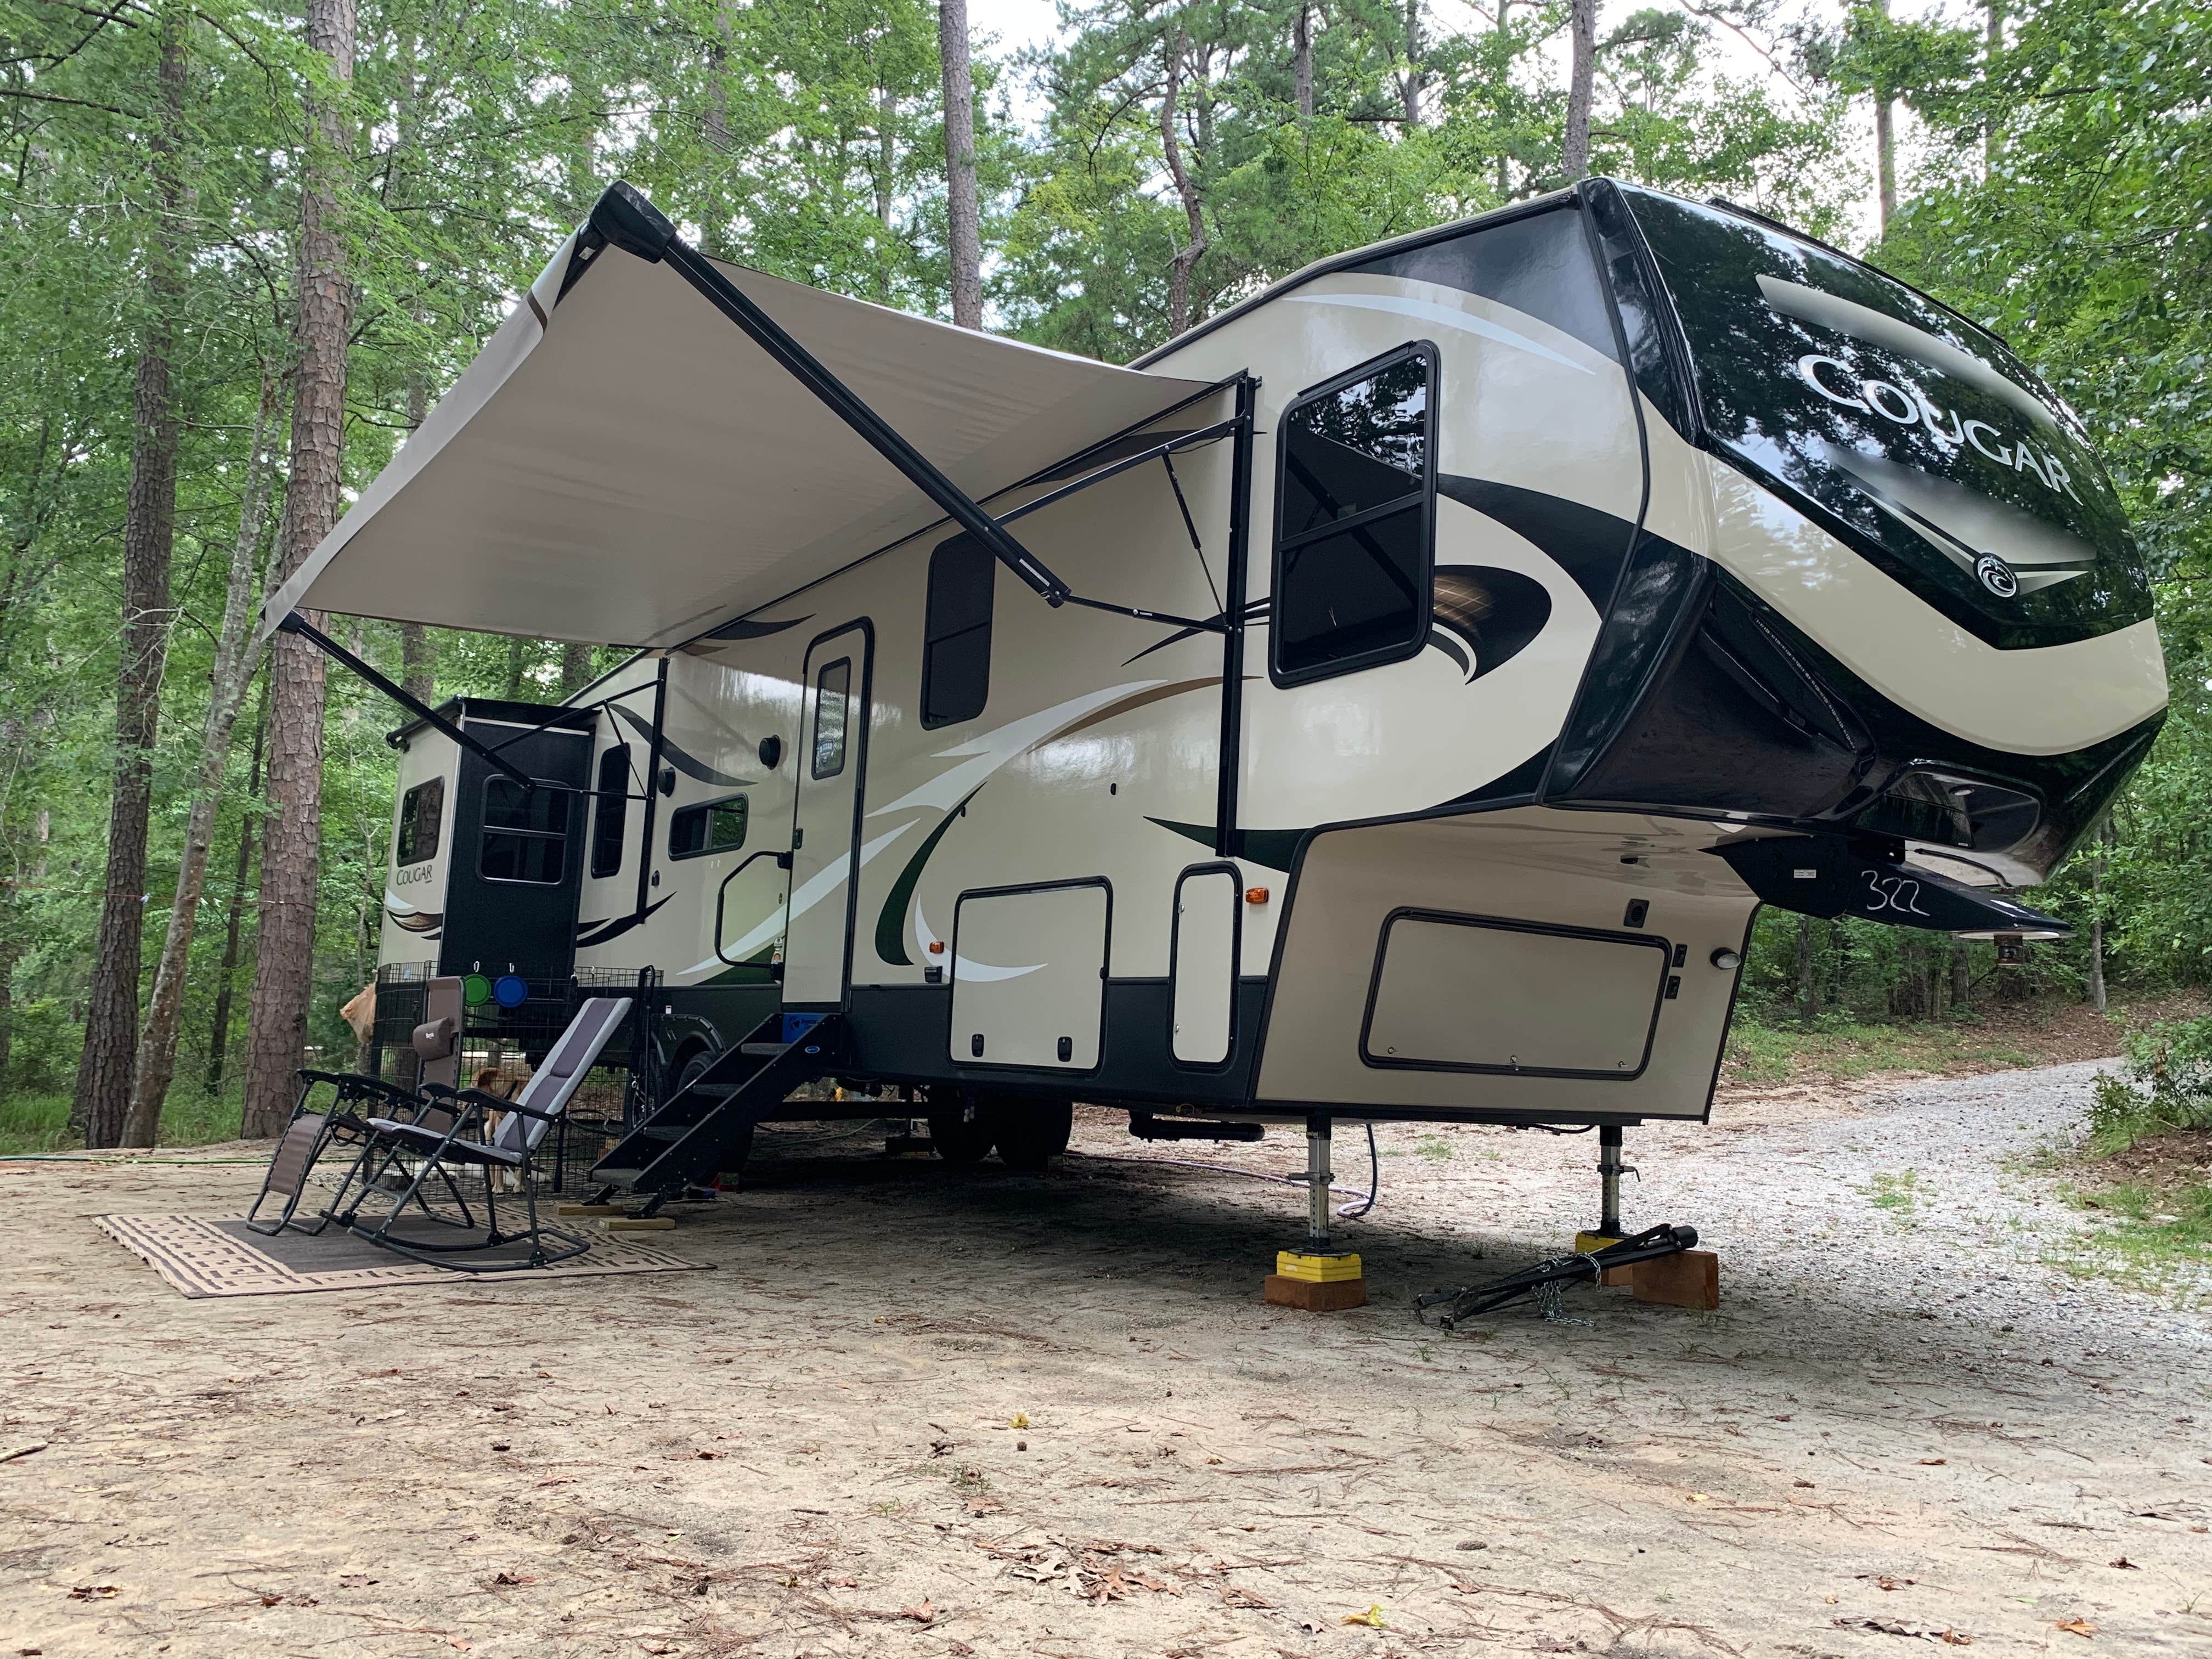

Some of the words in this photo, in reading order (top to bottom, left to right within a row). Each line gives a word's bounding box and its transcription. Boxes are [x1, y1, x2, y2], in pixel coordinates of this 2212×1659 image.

[1798, 354, 2083, 506] COUGAR
[397, 865, 432, 885] COUGAR
[1861, 870, 1930, 916] 322
